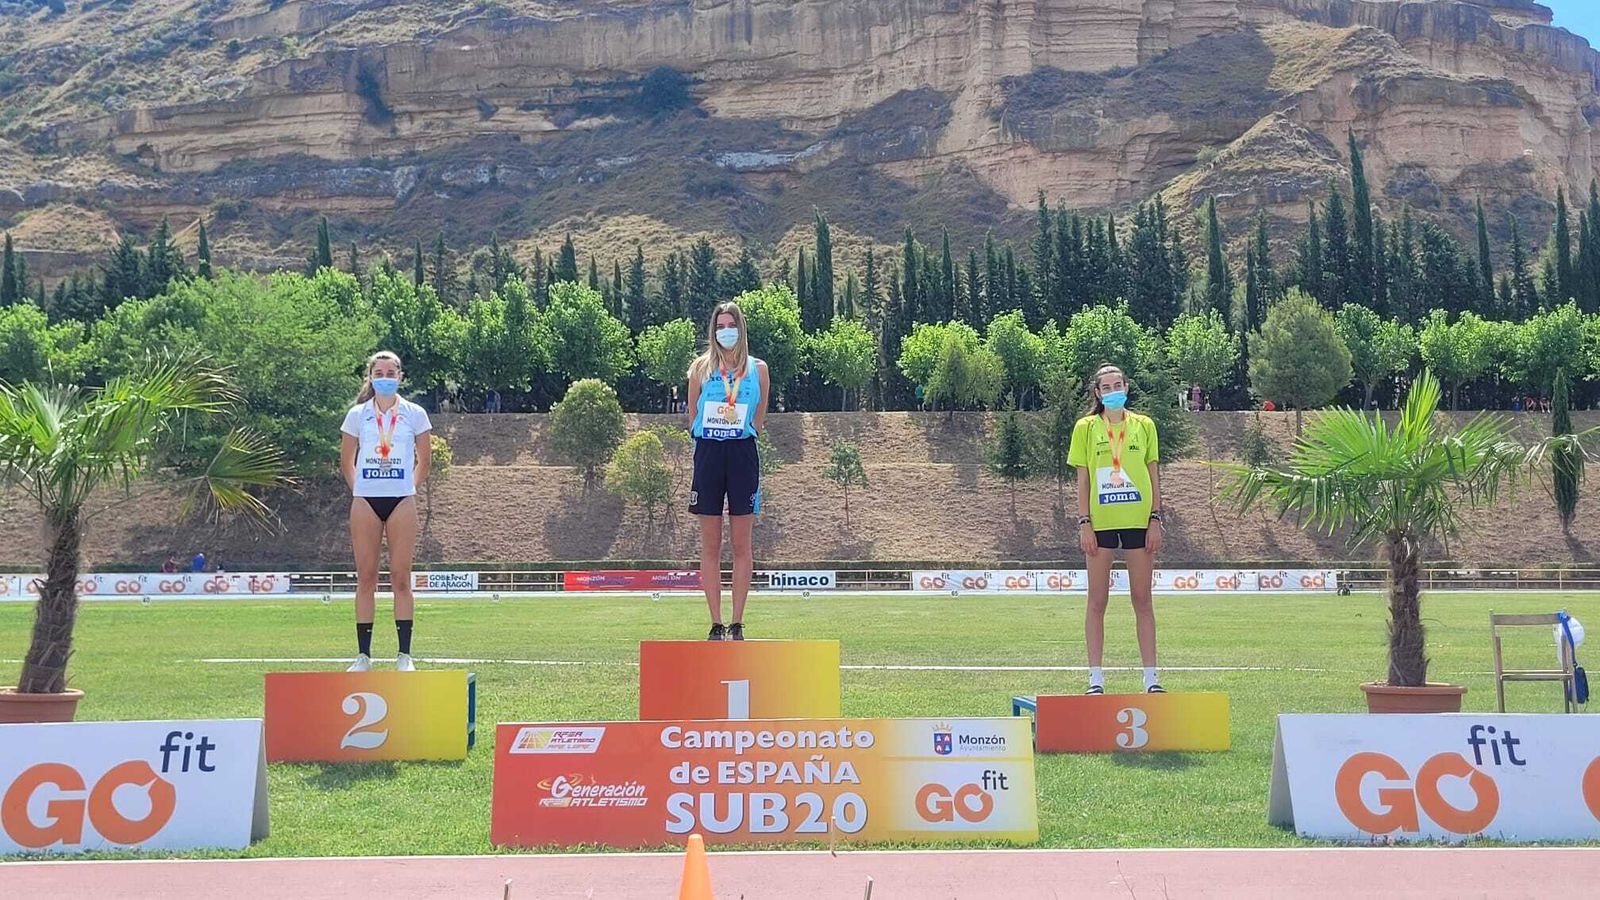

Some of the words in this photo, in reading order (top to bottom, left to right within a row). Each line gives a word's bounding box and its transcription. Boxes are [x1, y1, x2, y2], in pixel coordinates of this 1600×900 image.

[115, 580, 140, 593] GO
[159, 580, 185, 592] GO
[771, 572, 829, 586] hinaco
[920, 577, 945, 588] GO
[962, 577, 987, 589] GO
[1005, 576, 1030, 588] GO
[1174, 577, 1199, 588] GO
[1259, 575, 1283, 588] GO
[720, 679, 749, 720] 1
[340, 692, 389, 749] 2
[1115, 707, 1149, 749] 3
[661, 726, 875, 755] Campeonato
[959, 735, 1006, 745] Monzón
[669, 761, 711, 784] de
[718, 754, 861, 785] ESPAÑA
[551, 775, 646, 798] Generación
[1334, 752, 1499, 834] GO
[1467, 724, 1527, 766] fit
[1, 760, 176, 848] GO
[160, 731, 216, 773] fit
[915, 783, 994, 823] GO
[981, 770, 1009, 790] fit
[569, 797, 648, 807] ATLETISMO
[665, 792, 868, 834] SUB20
